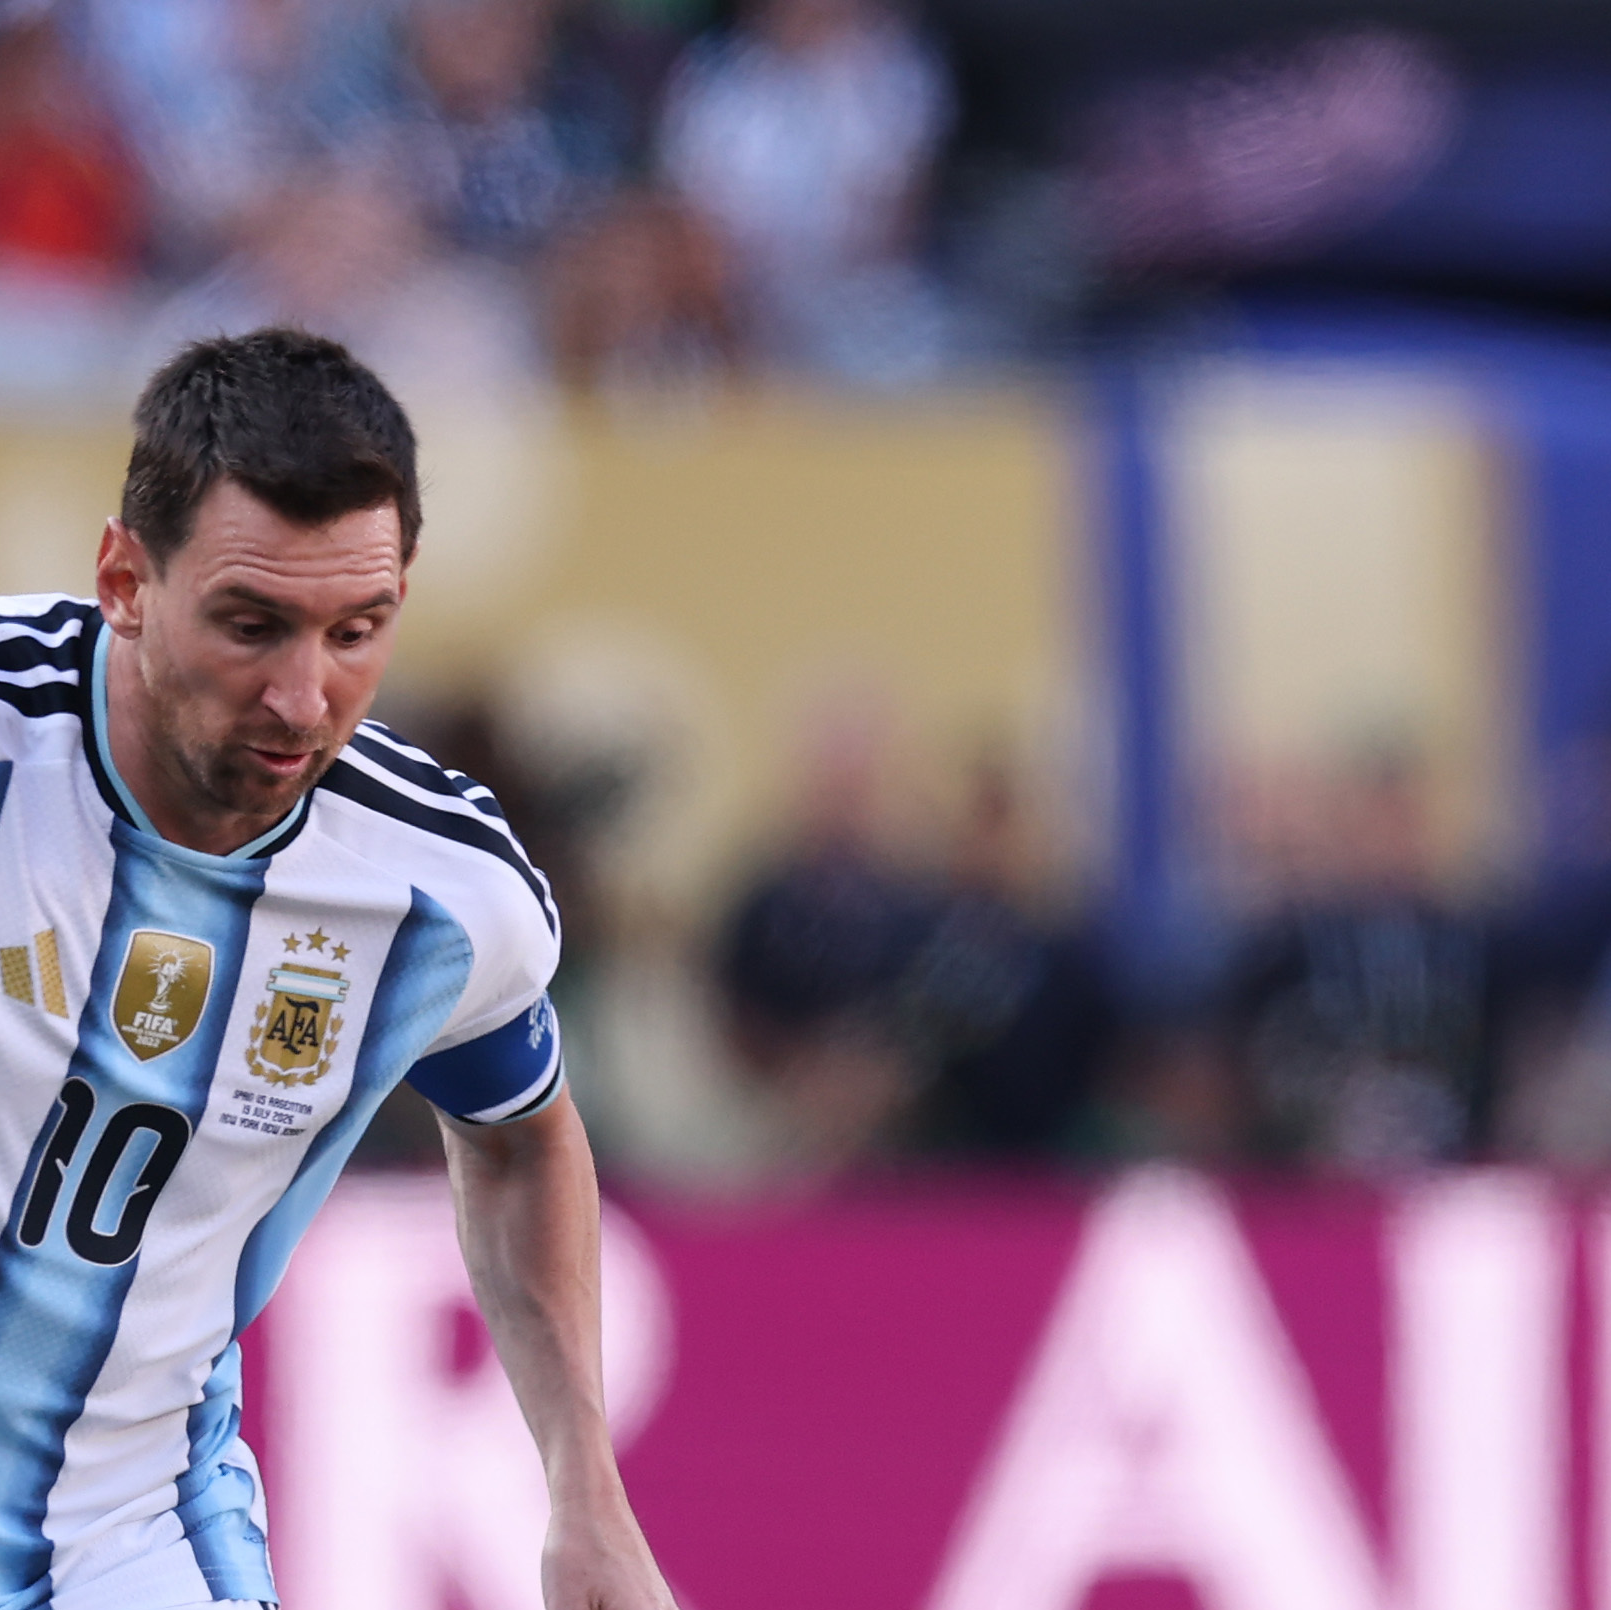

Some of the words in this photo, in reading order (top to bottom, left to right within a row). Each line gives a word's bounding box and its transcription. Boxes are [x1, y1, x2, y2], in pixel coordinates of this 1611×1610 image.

[133, 1011, 174, 1034] FIFA
[252, 1106, 271, 1119] JULY
[272, 1111, 295, 1125] 2026
[268, 1096, 313, 1116] ARGENTINA
[239, 1117, 260, 1131] YORK
[16, 1075, 193, 1268] 10
